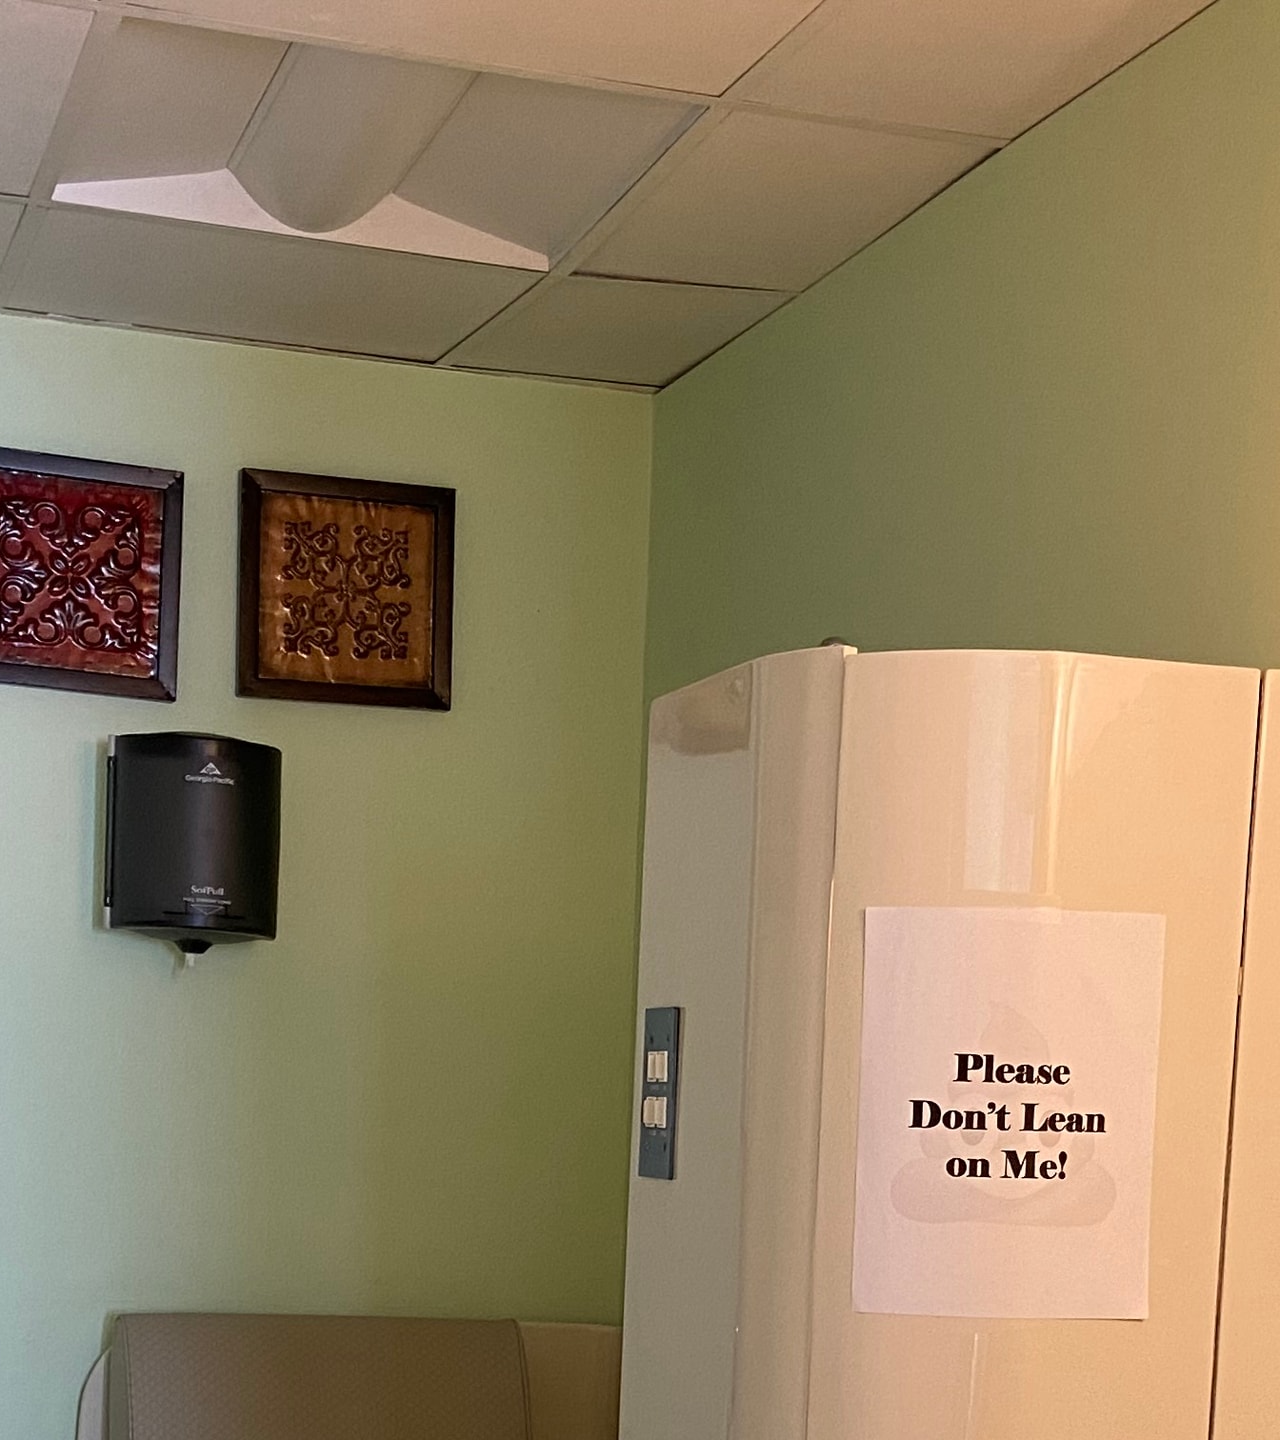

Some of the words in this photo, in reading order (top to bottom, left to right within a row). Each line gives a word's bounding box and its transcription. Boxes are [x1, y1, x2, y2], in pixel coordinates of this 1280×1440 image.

[953, 1052, 1071, 1086] Please
[908, 1099, 1011, 1133] Don't
[1019, 1102, 1106, 1134] Lean
[945, 1155, 990, 1179] on
[1000, 1150, 1068, 1181] Me!
